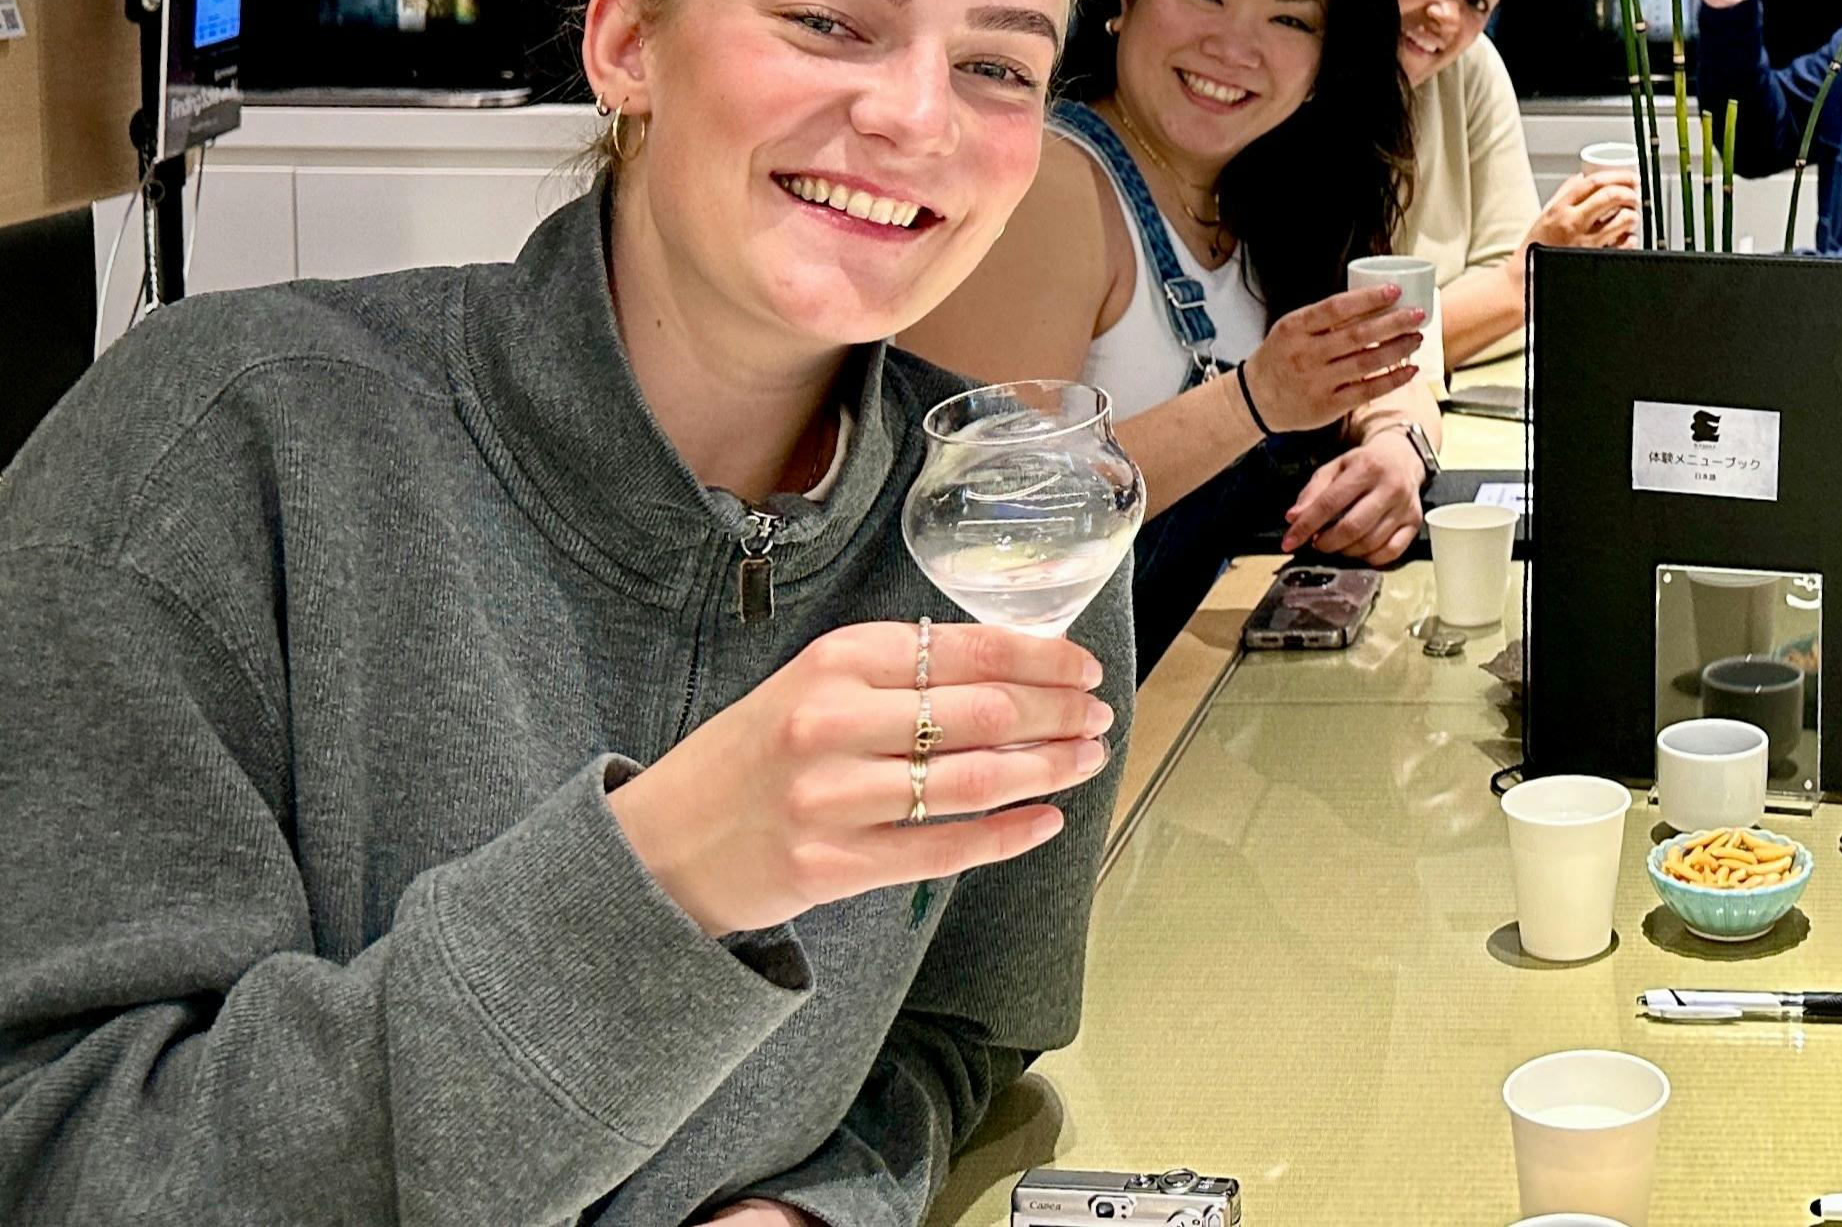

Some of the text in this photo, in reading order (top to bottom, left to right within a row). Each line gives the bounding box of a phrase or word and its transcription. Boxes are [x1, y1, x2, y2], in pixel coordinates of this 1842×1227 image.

[1649, 451, 1760, 471] 体験メニューブック
